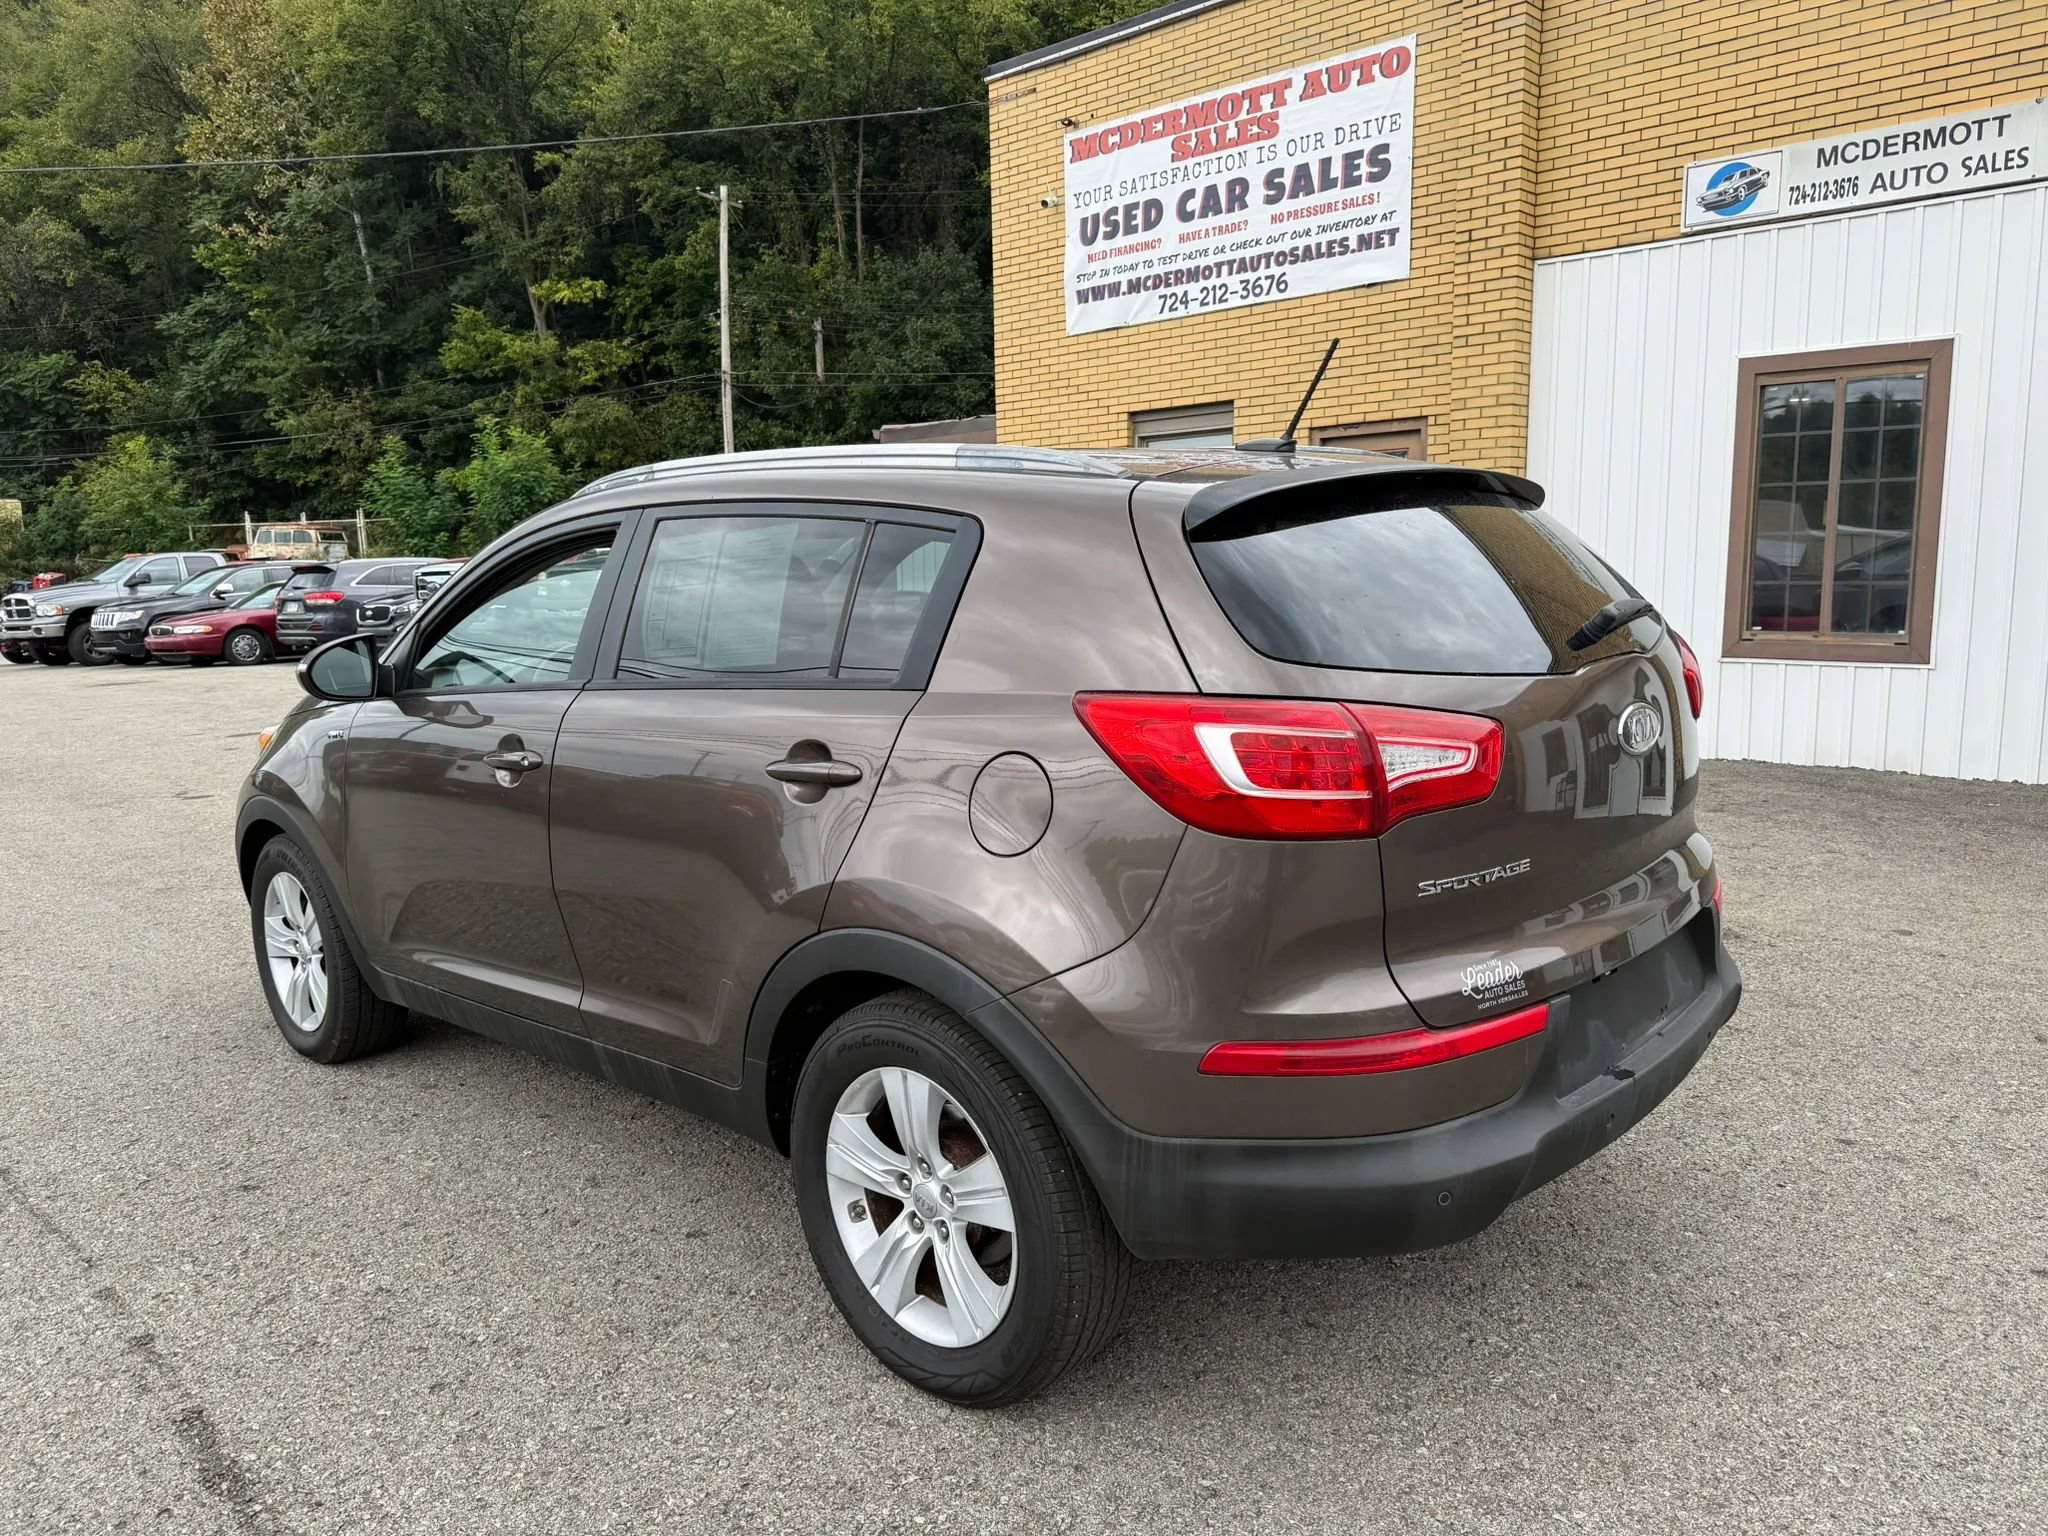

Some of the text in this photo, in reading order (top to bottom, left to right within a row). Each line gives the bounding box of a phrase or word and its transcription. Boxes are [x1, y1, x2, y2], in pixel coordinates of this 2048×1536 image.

[1070, 45, 1412, 164] MCDERMOTT AUTO
[1171, 110, 1279, 163] SALES
[1816, 114, 2012, 169] MCDERMOTT
[1073, 113, 1401, 209] YOUR SATISFACTION IS OUR DRIVE
[1788, 146, 2030, 207] 724-212-3676 AUTO SALES
[1079, 143, 1392, 247] USED CAR SALES
[1270, 211, 1285, 225] NO
[1286, 201, 1340, 222] PRESSURE
[1076, 210, 1397, 283] STOP IN TODAY TO TEST DRIVE OR CHECK OUT OUR INVENTORY AT
[1087, 237, 1162, 264] NEED FINANCING?
[1178, 219, 1249, 244] HAVE A TRADE?
[1076, 227, 1400, 305] WWW.MCDERMOTTAUTOSALES.NET
[1158, 271, 1289, 315] 724-212-3676
[1418, 858, 1531, 897] SPORTAGE
[1460, 960, 1523, 999] Leader
[1478, 990, 1529, 1010] NORTH VERSAILLES
[1485, 980, 1526, 999] AUTO SALES
